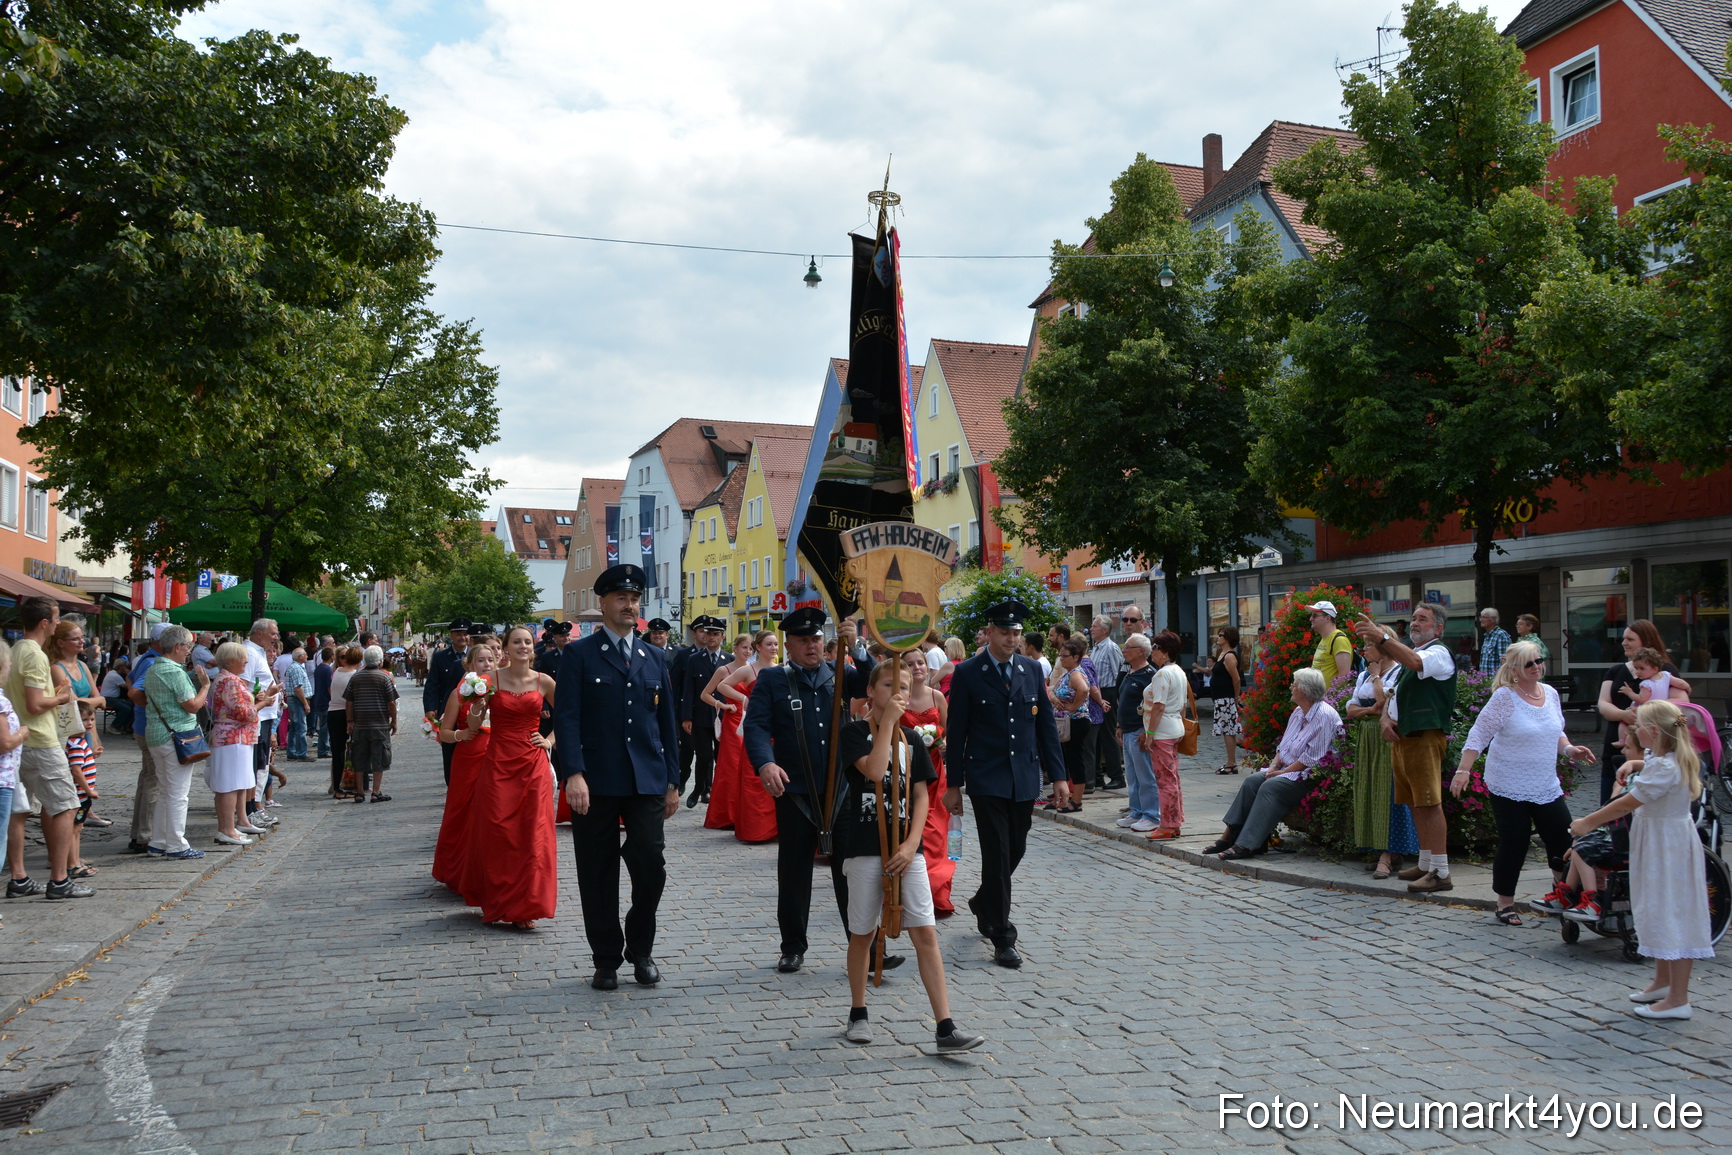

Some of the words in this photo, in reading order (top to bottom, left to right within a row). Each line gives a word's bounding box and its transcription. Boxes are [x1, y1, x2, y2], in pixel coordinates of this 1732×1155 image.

[641, 527, 652, 555] K&L
[851, 525, 950, 560] FFW-HAUSHEIM
[704, 551, 717, 566] HOTEL
[200, 572, 208, 586] P
